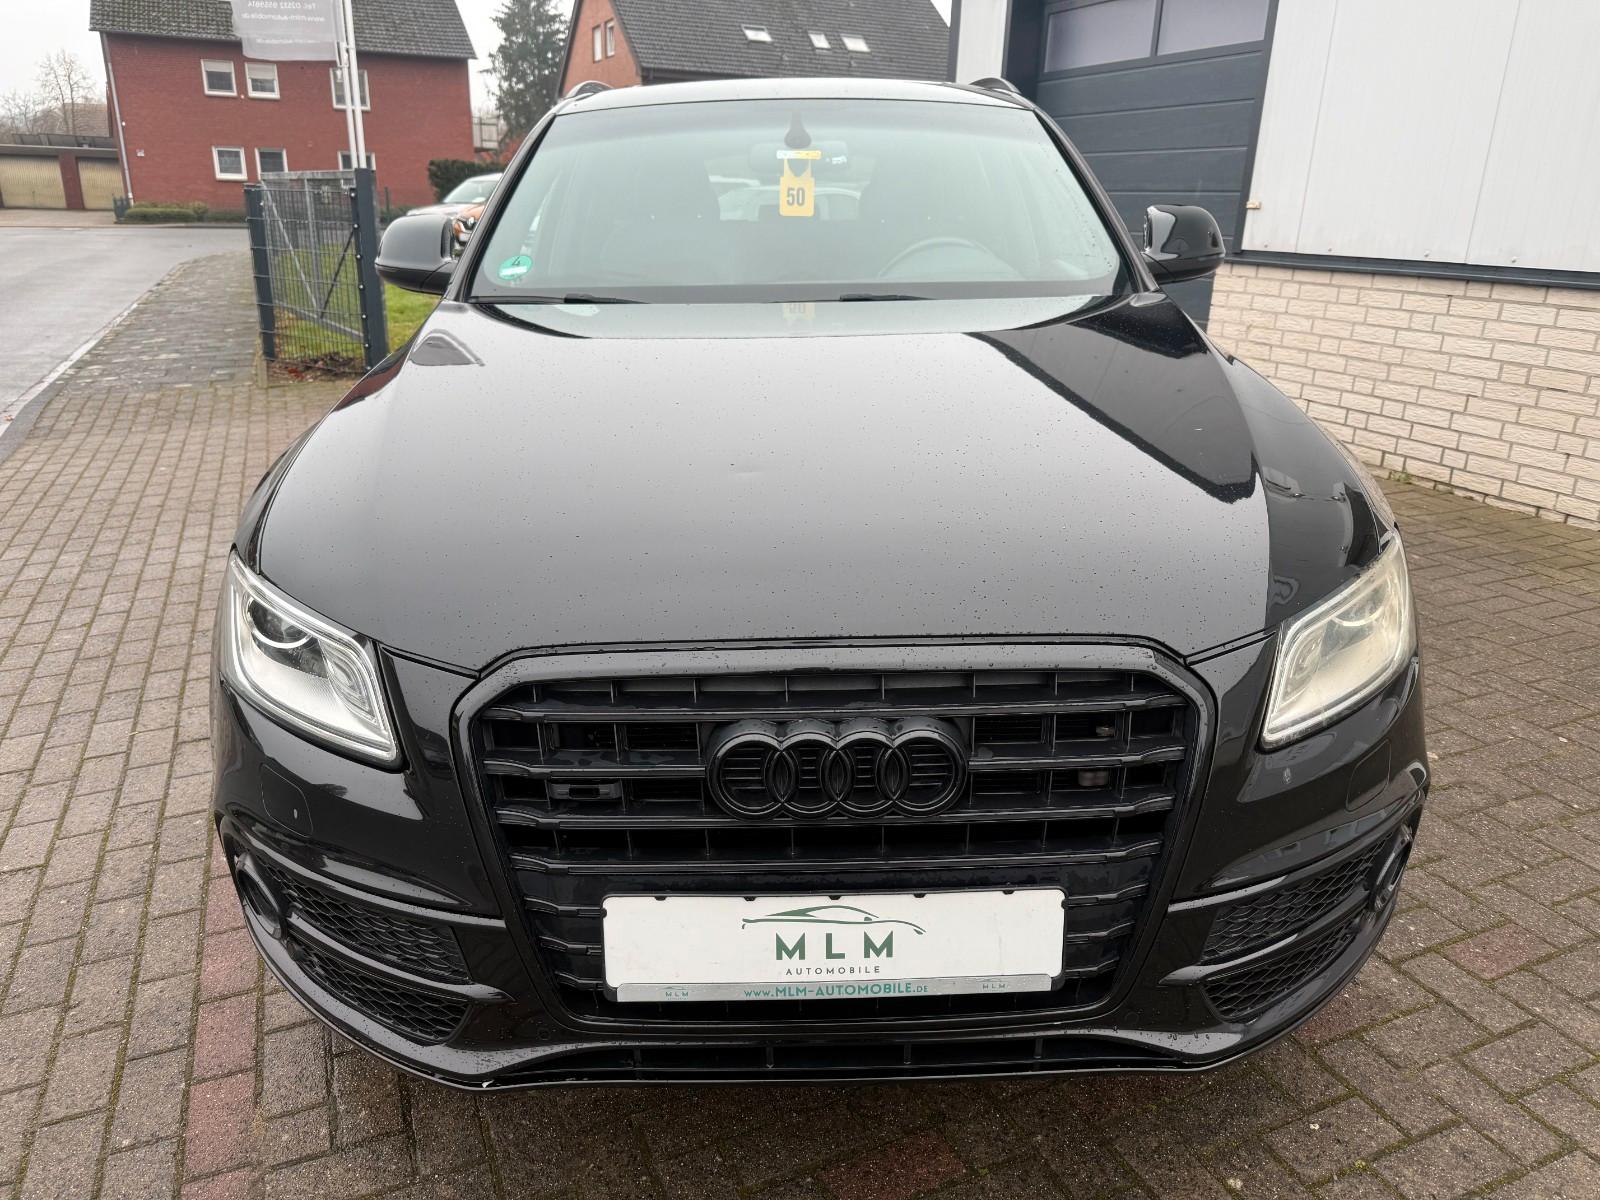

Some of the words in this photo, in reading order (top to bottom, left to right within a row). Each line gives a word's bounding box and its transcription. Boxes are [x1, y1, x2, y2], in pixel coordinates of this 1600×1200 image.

[786, 187, 806, 207] 50
[775, 930, 894, 961] MLM
[785, 965, 881, 976] AUTOMOBILE
[743, 982, 929, 998] www.MLM-AUTOMOBILE.DE
